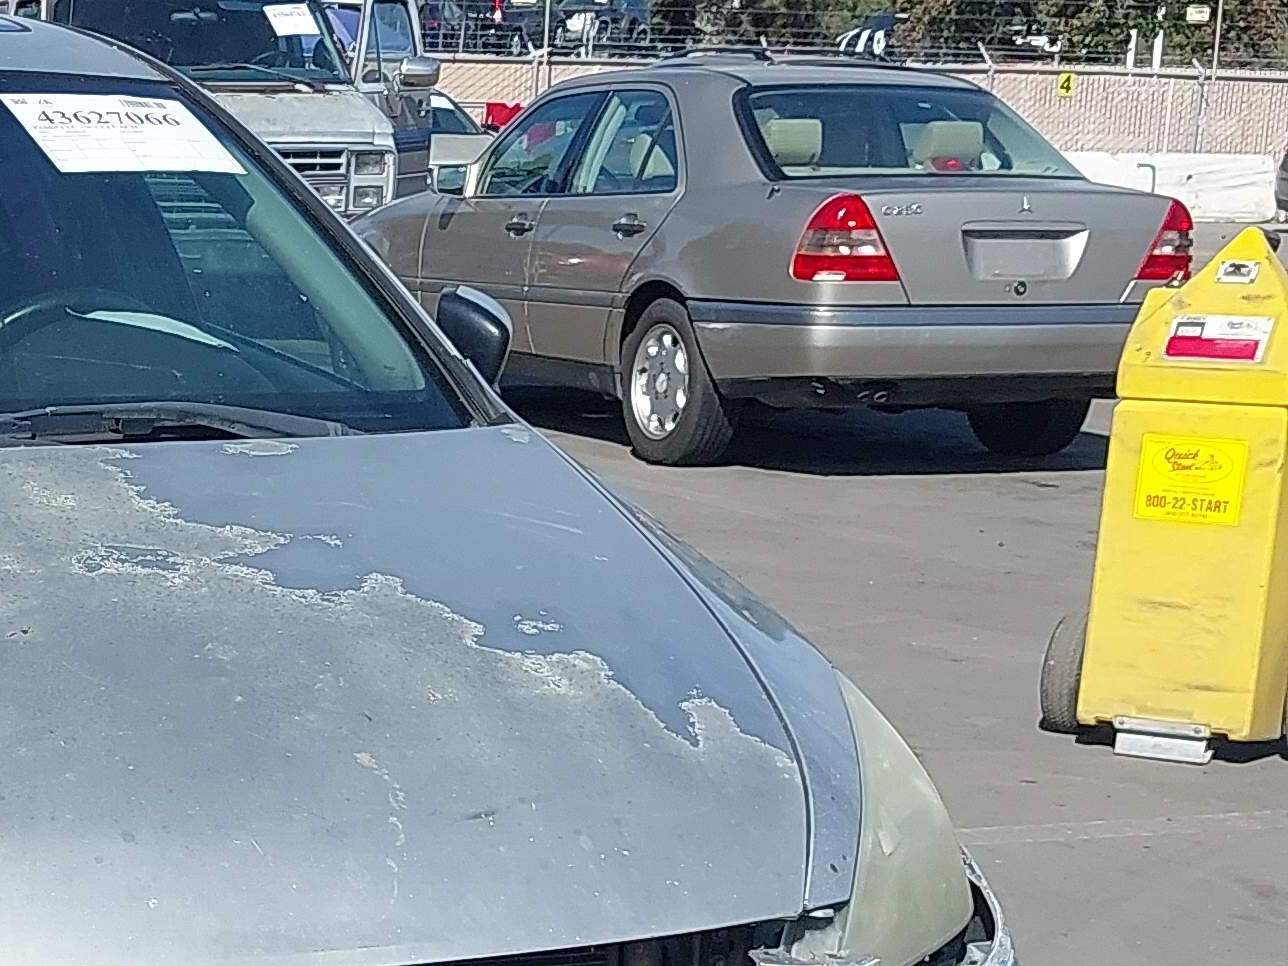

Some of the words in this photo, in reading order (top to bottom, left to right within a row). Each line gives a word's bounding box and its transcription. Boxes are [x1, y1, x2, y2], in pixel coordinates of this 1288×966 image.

[1059, 74, 1072, 93] 4
[37, 110, 181, 127] 43627066
[1165, 448, 1200, 464] Quick
[1145, 494, 1230, 514] 800-22-START
